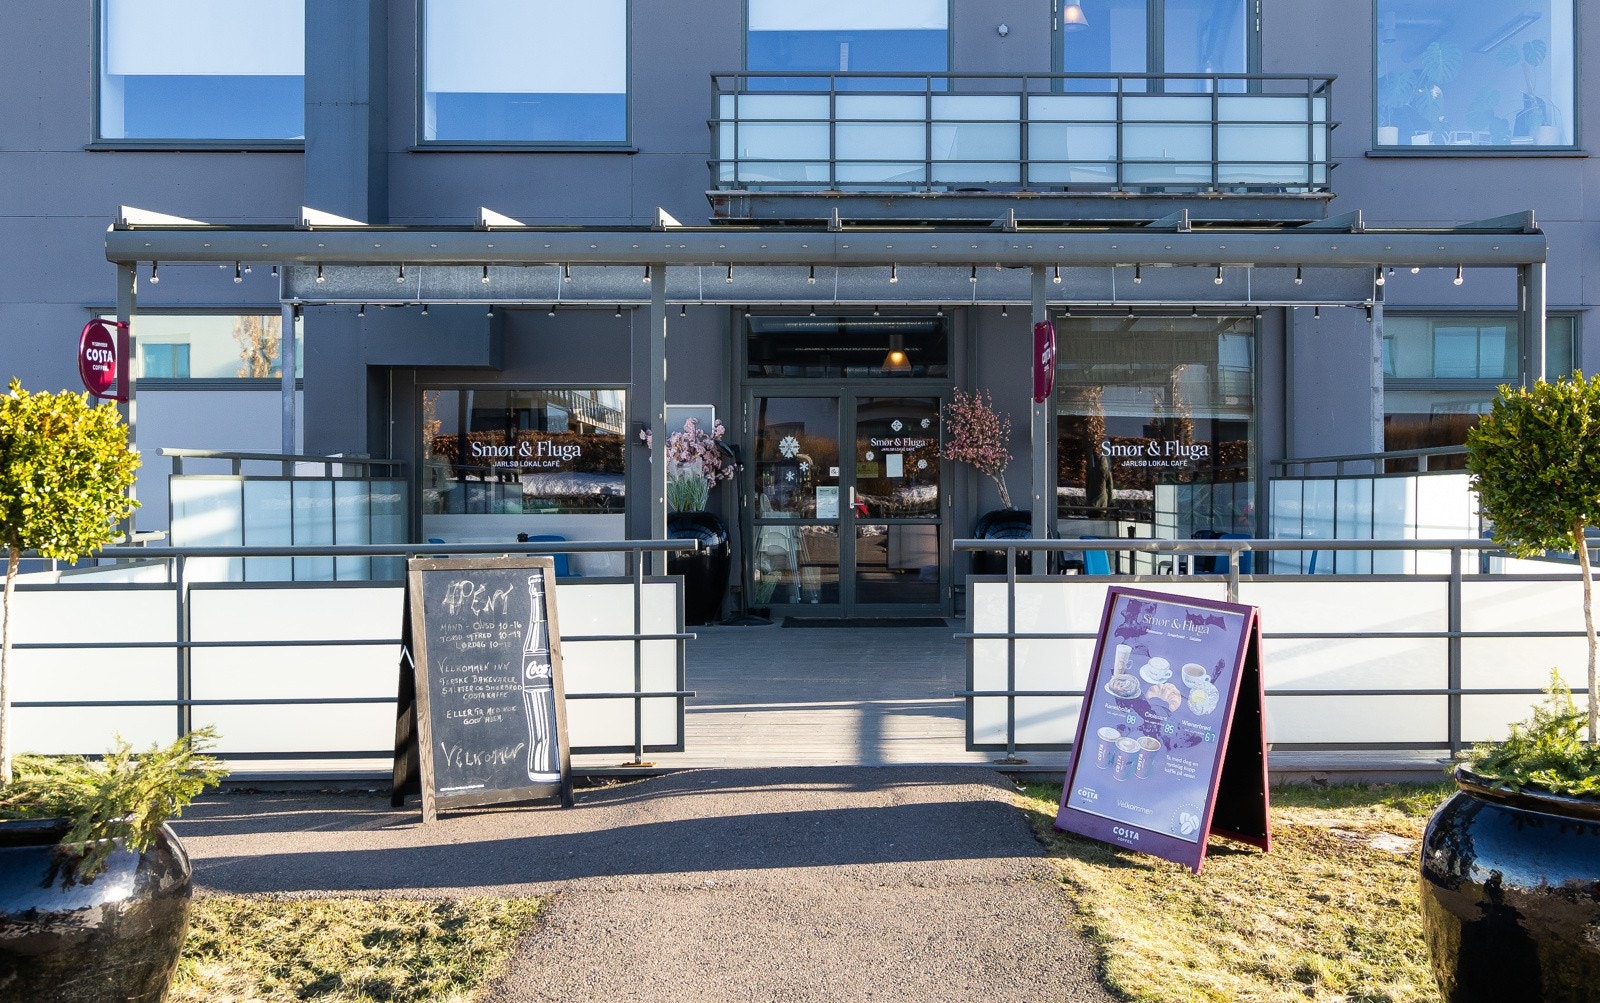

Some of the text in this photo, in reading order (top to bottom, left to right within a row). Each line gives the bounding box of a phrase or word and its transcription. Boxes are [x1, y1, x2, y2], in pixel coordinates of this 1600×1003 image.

[86, 348, 114, 363] COSTA
[471, 440, 582, 461] Smør & Fluga
[870, 437, 926, 449] Smør & Fluga
[1101, 440, 1209, 460] Smør & Fluga
[1170, 459, 1188, 467] CAFÉ
[1170, 618, 1181, 630] &
[1182, 619, 1210, 637] Fluga
[446, 708, 473, 719] ELLER
[1077, 788, 1098, 800] COSTA
[1116, 799, 1154, 816] Velkommen
[1112, 826, 1140, 841] COSTA
